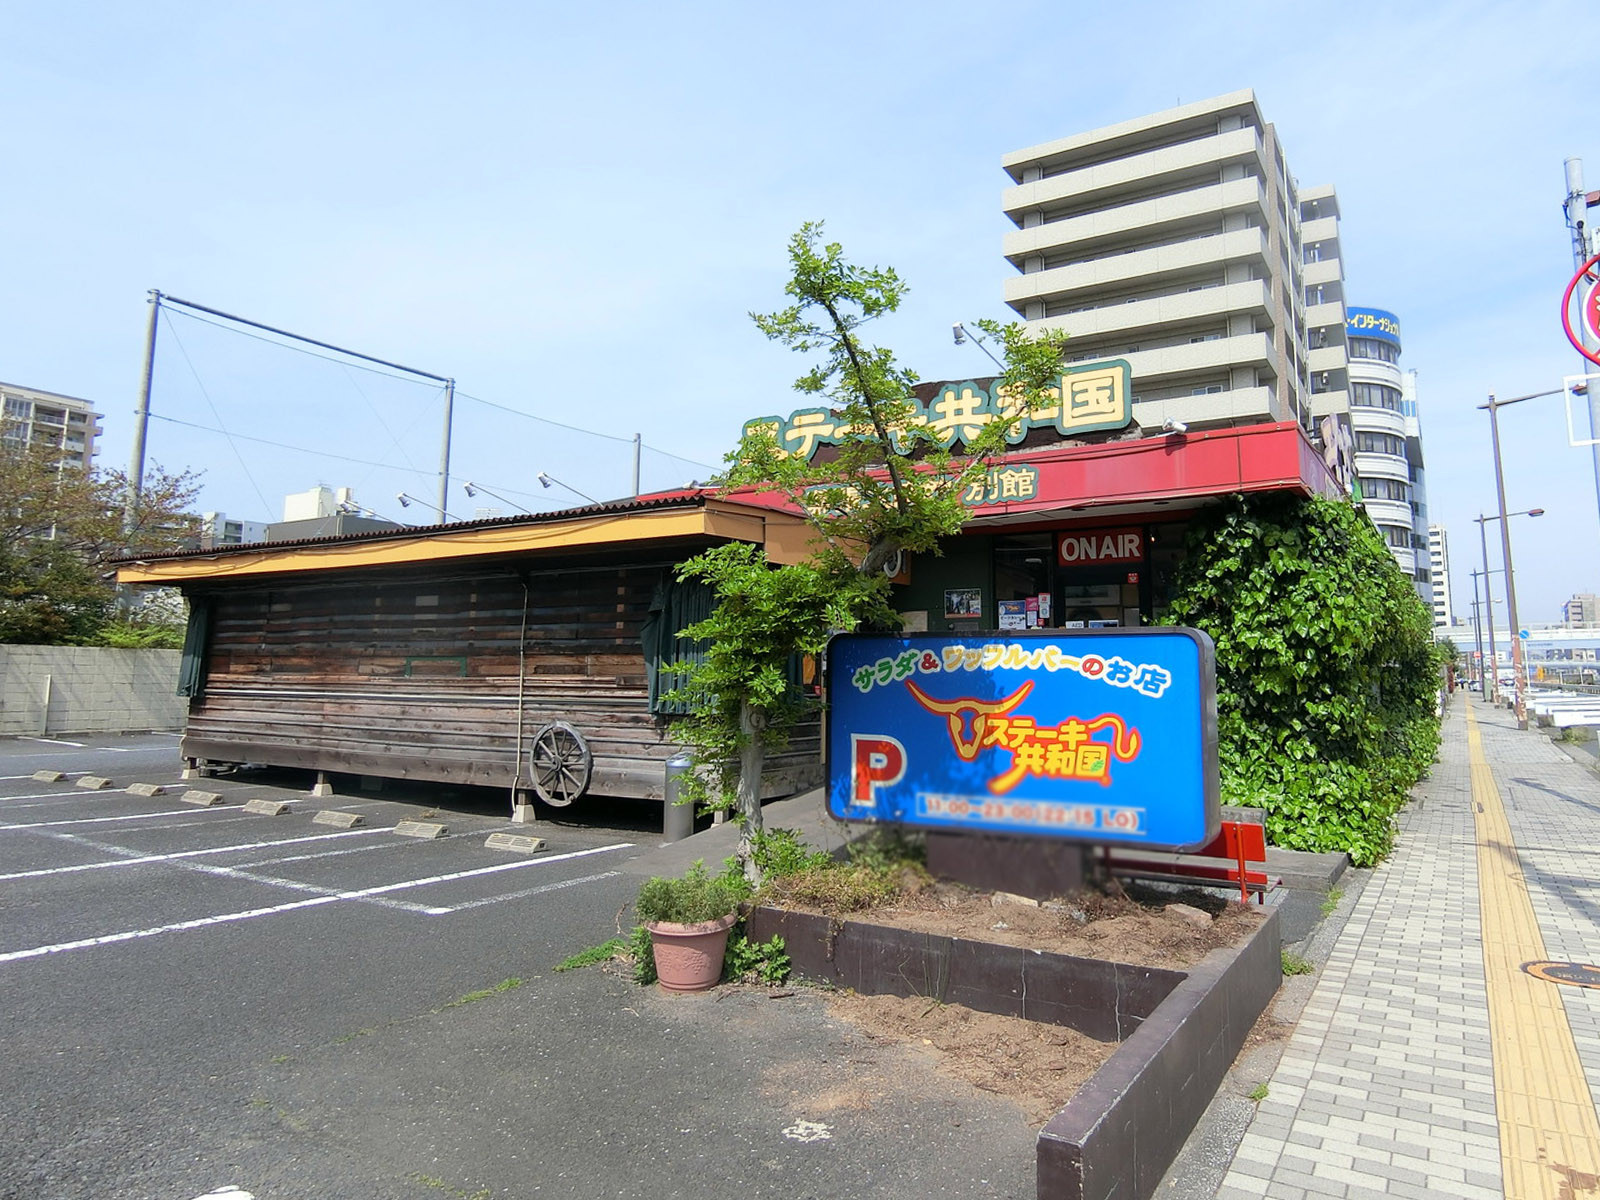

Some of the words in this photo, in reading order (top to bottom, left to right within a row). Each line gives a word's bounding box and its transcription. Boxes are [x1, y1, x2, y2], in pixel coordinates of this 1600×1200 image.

[965, 467, 1035, 502] 別館
[984, 720, 1089, 750] ステーキ
[851, 734, 908, 807] P
[994, 742, 1108, 789] 共和国
